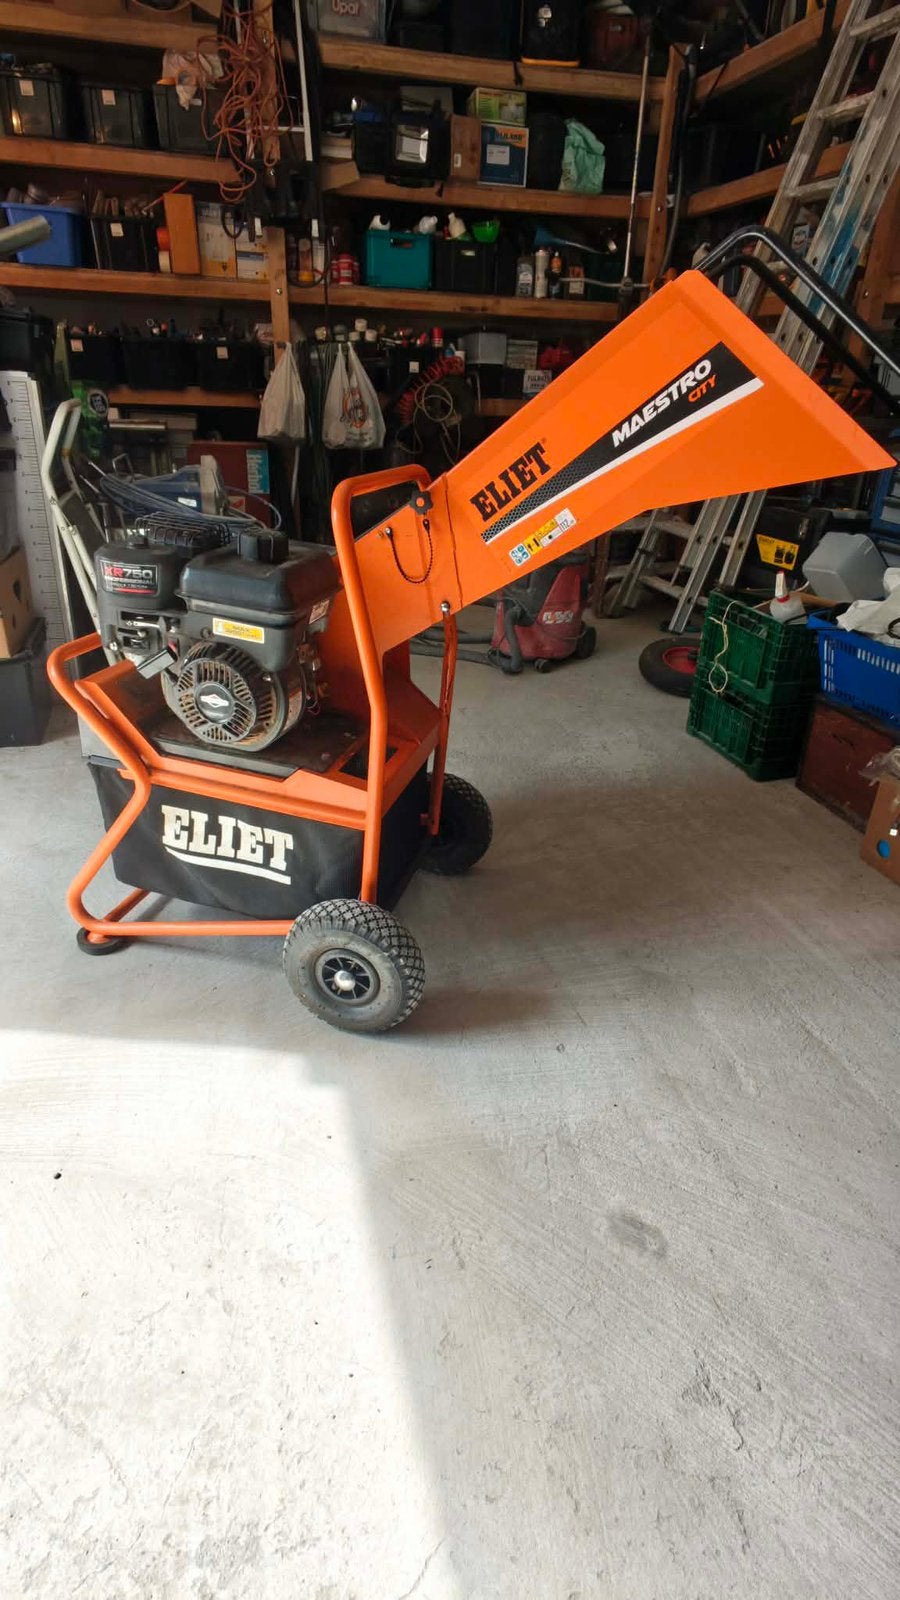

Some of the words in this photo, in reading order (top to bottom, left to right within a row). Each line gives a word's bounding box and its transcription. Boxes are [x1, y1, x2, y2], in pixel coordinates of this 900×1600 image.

[611, 355, 712, 448] MAESTRO
[688, 374, 717, 403] CITY
[469, 442, 551, 522] ELIET
[161, 805, 294, 872] ELIET
